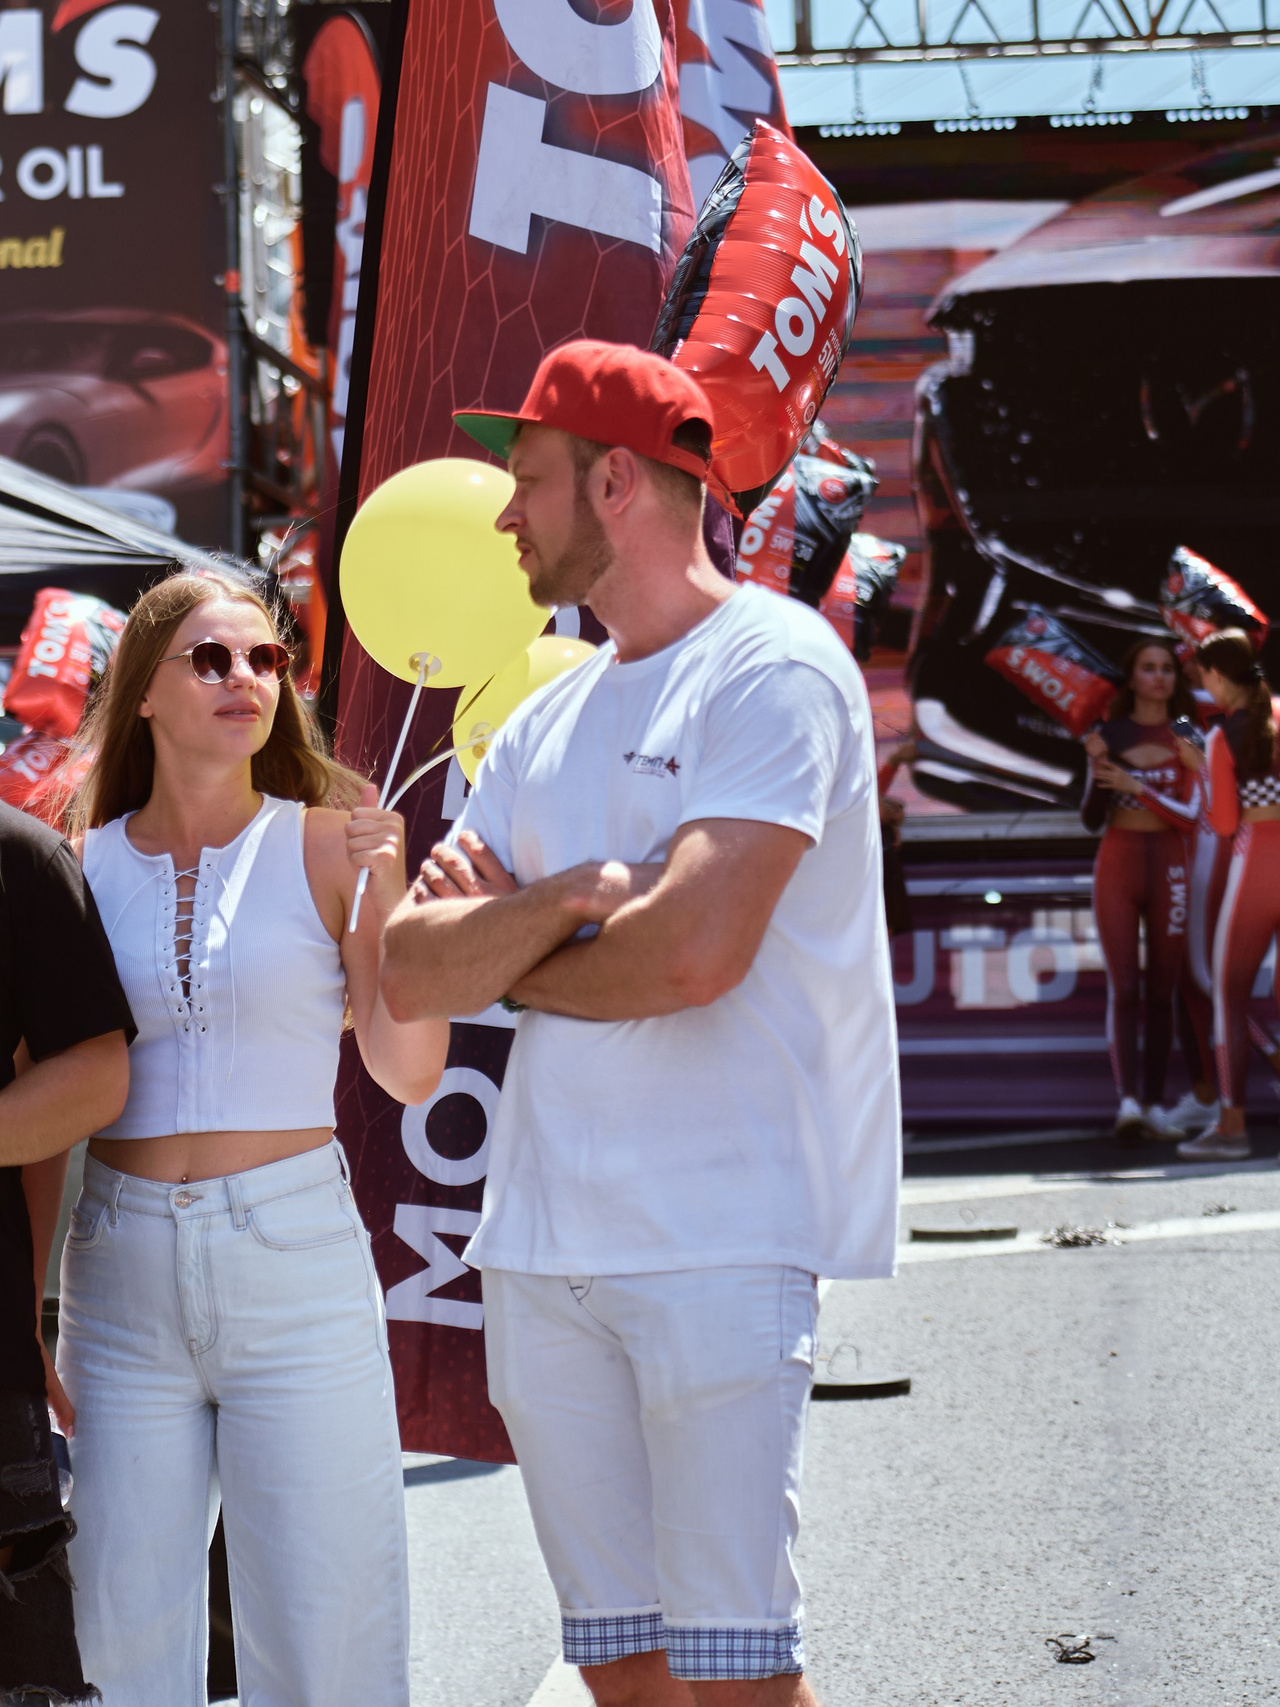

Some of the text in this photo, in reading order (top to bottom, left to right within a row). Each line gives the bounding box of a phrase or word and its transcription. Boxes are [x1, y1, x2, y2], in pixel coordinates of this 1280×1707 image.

[16, 144, 125, 200] OIL
[748, 194, 846, 394] TOM'S
[1166, 865, 1187, 937] TOM'S
